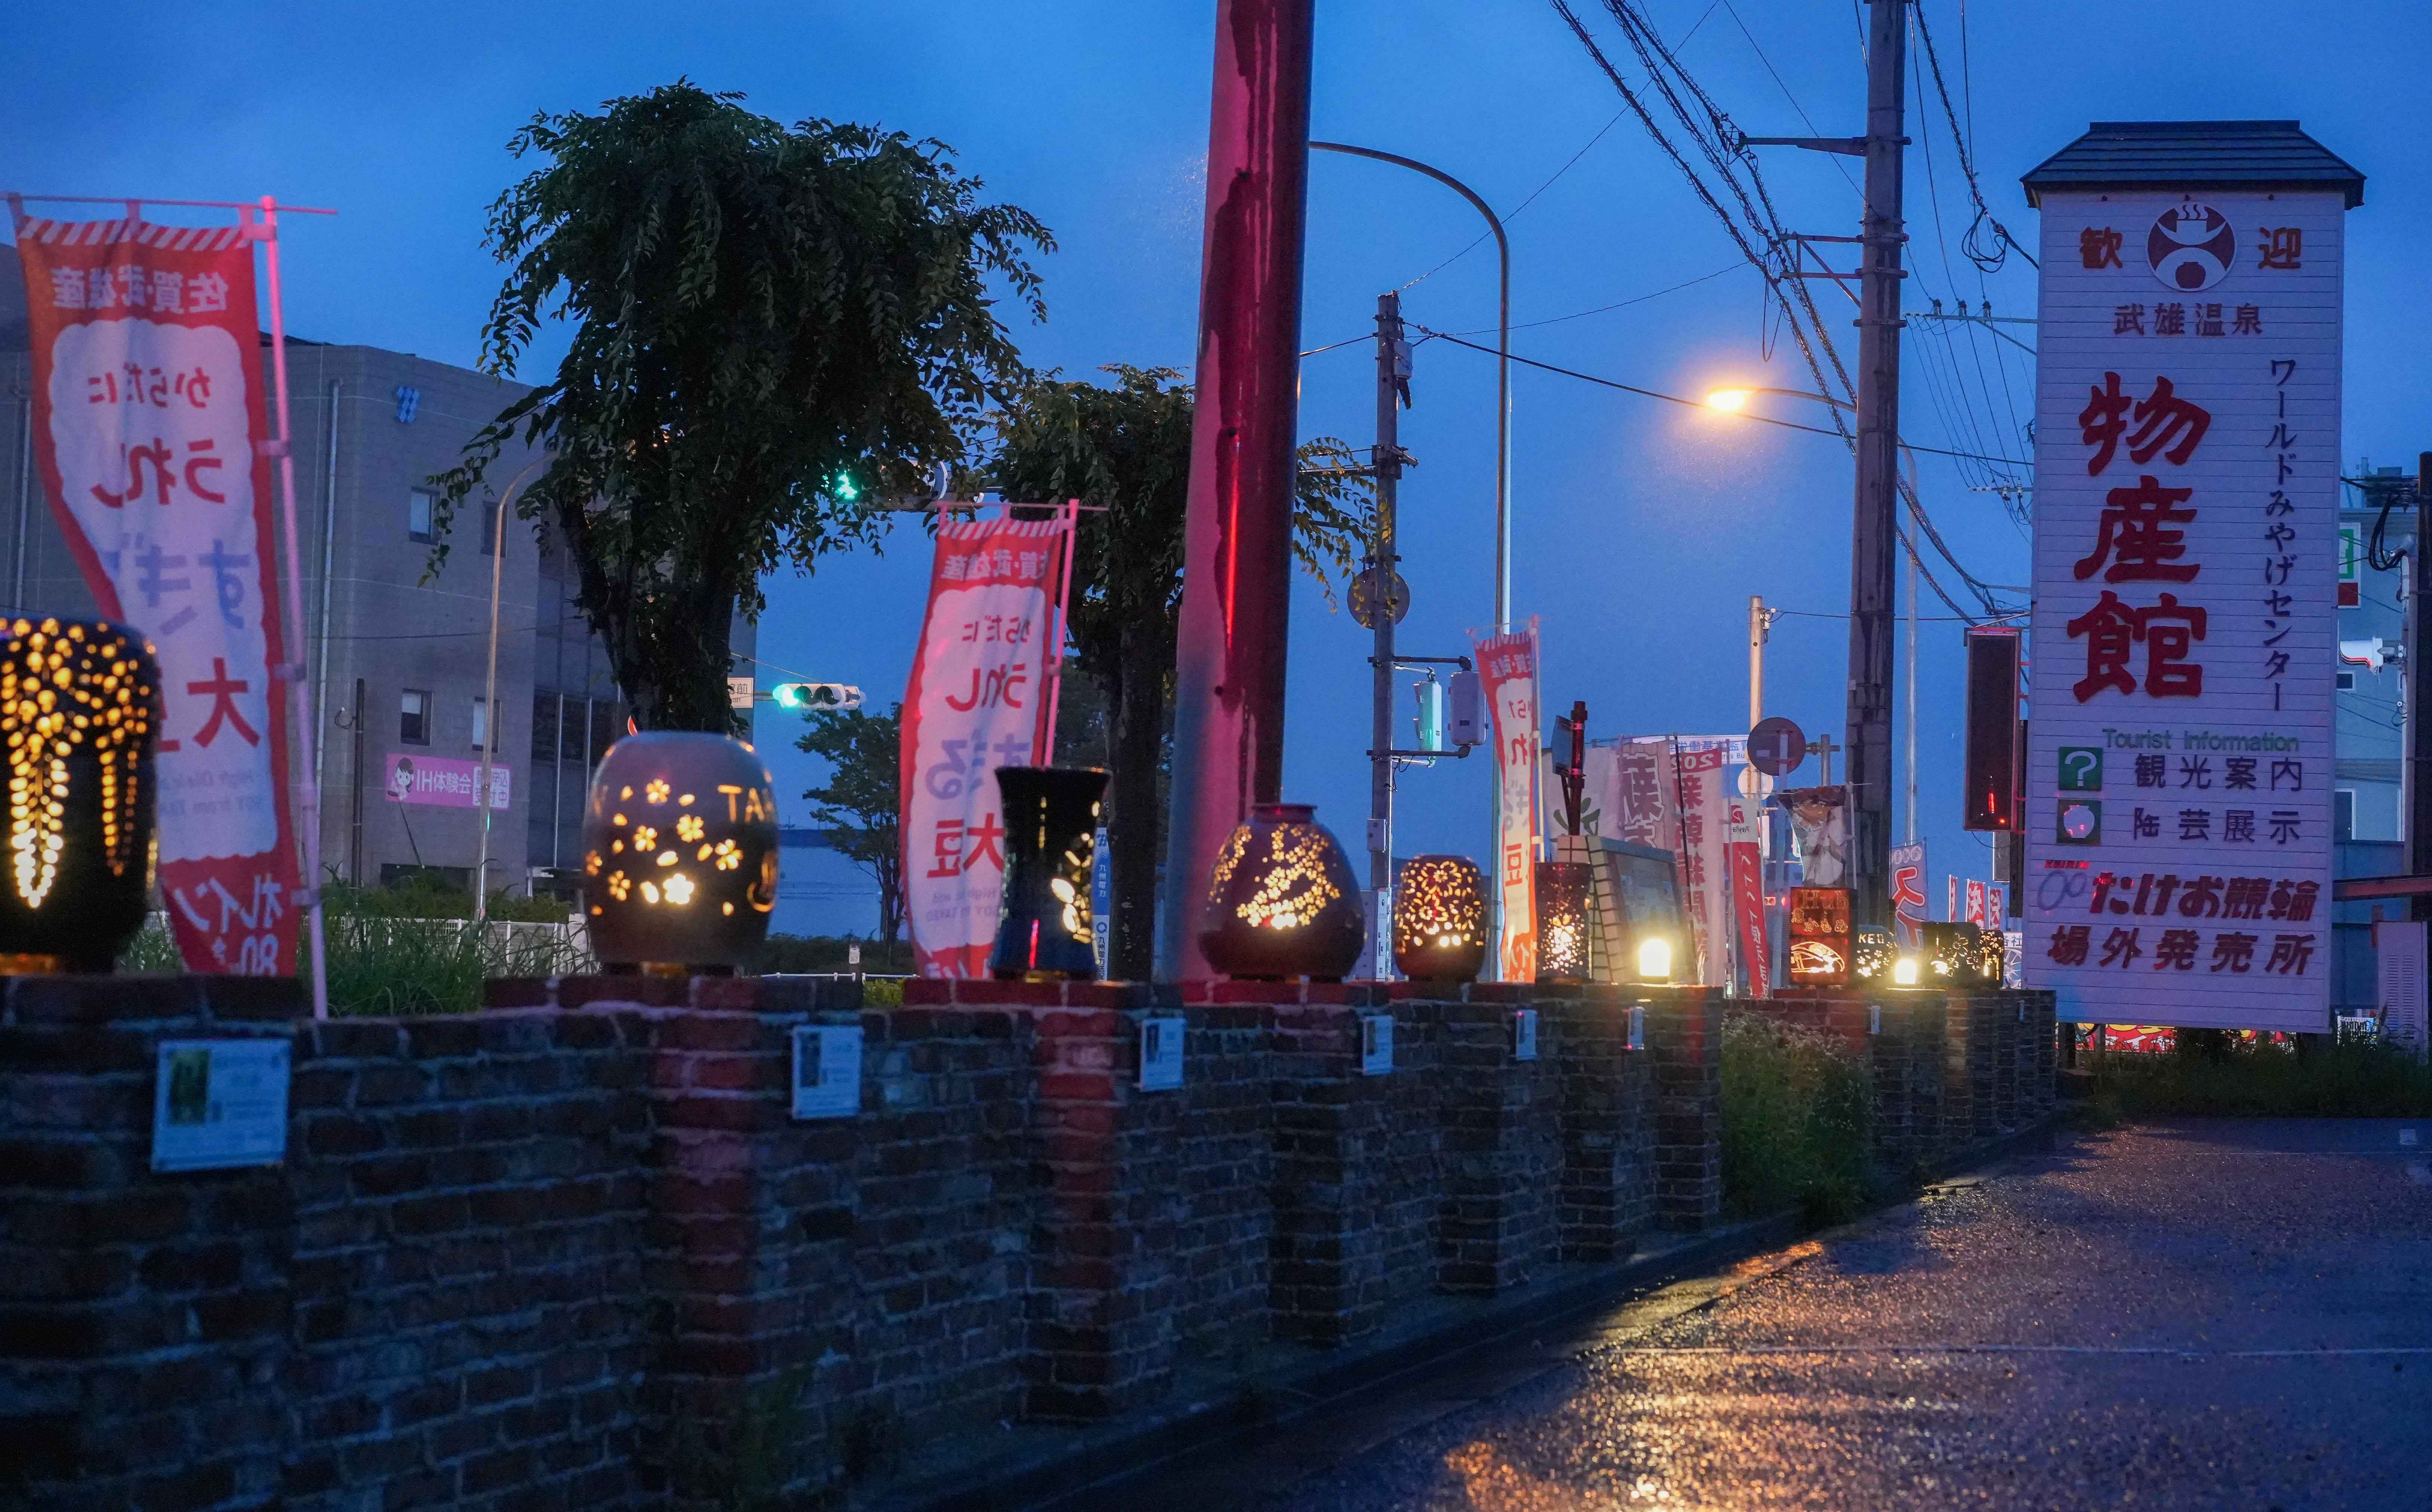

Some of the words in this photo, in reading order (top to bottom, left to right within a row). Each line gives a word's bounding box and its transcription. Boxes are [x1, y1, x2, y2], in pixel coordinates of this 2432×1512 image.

[2079, 227, 2123, 270] 歓
[2257, 227, 2302, 270] 迎
[2114, 302, 2263, 337] 武雄温泉
[2067, 372, 2211, 703] 物産館
[2263, 358, 2298, 712] ワールドみやげセンター
[2102, 728, 2172, 749] Tourist
[2185, 730, 2299, 752] Information
[2134, 753, 2302, 792] 観光案内
[2090, 870, 2321, 922] たけお競輪
[2047, 925, 2316, 975] 場外発売所
